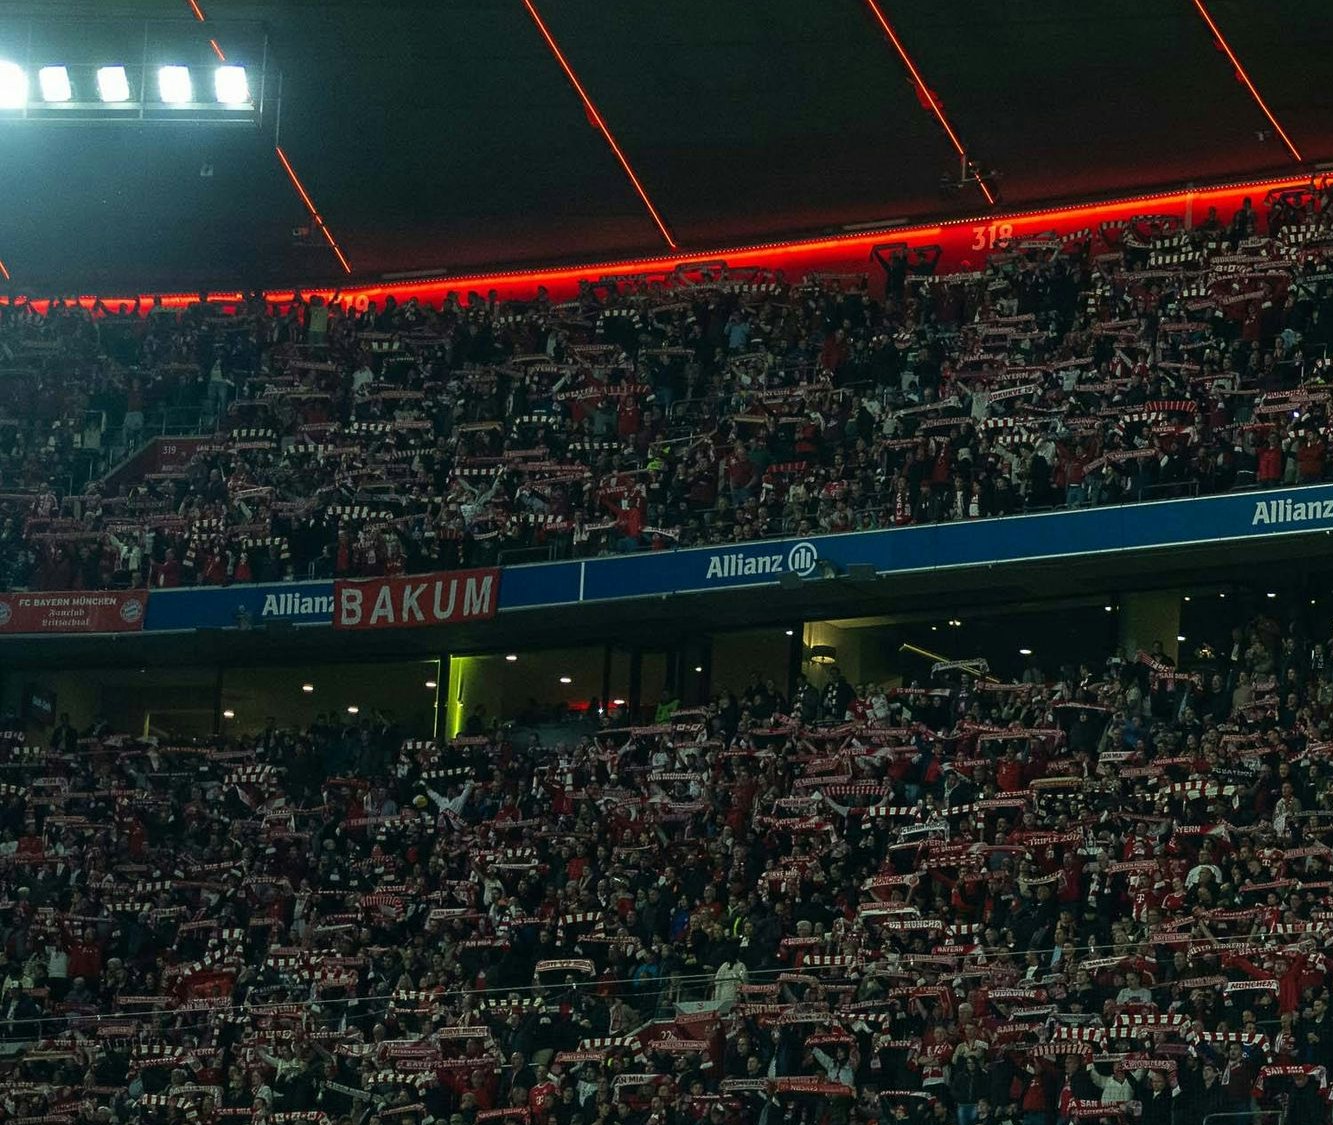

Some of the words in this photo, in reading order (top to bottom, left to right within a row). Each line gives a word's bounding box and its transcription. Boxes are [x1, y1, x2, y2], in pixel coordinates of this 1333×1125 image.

[972, 225, 1013, 252] 318
[162, 445, 177, 455] 319
[706, 552, 783, 580] Allianz
[19, 598, 34, 607] FC
[36, 597, 70, 607] BAYERN
[72, 595, 117, 606] MÜNCHEN
[340, 576, 493, 626] BAKUM
